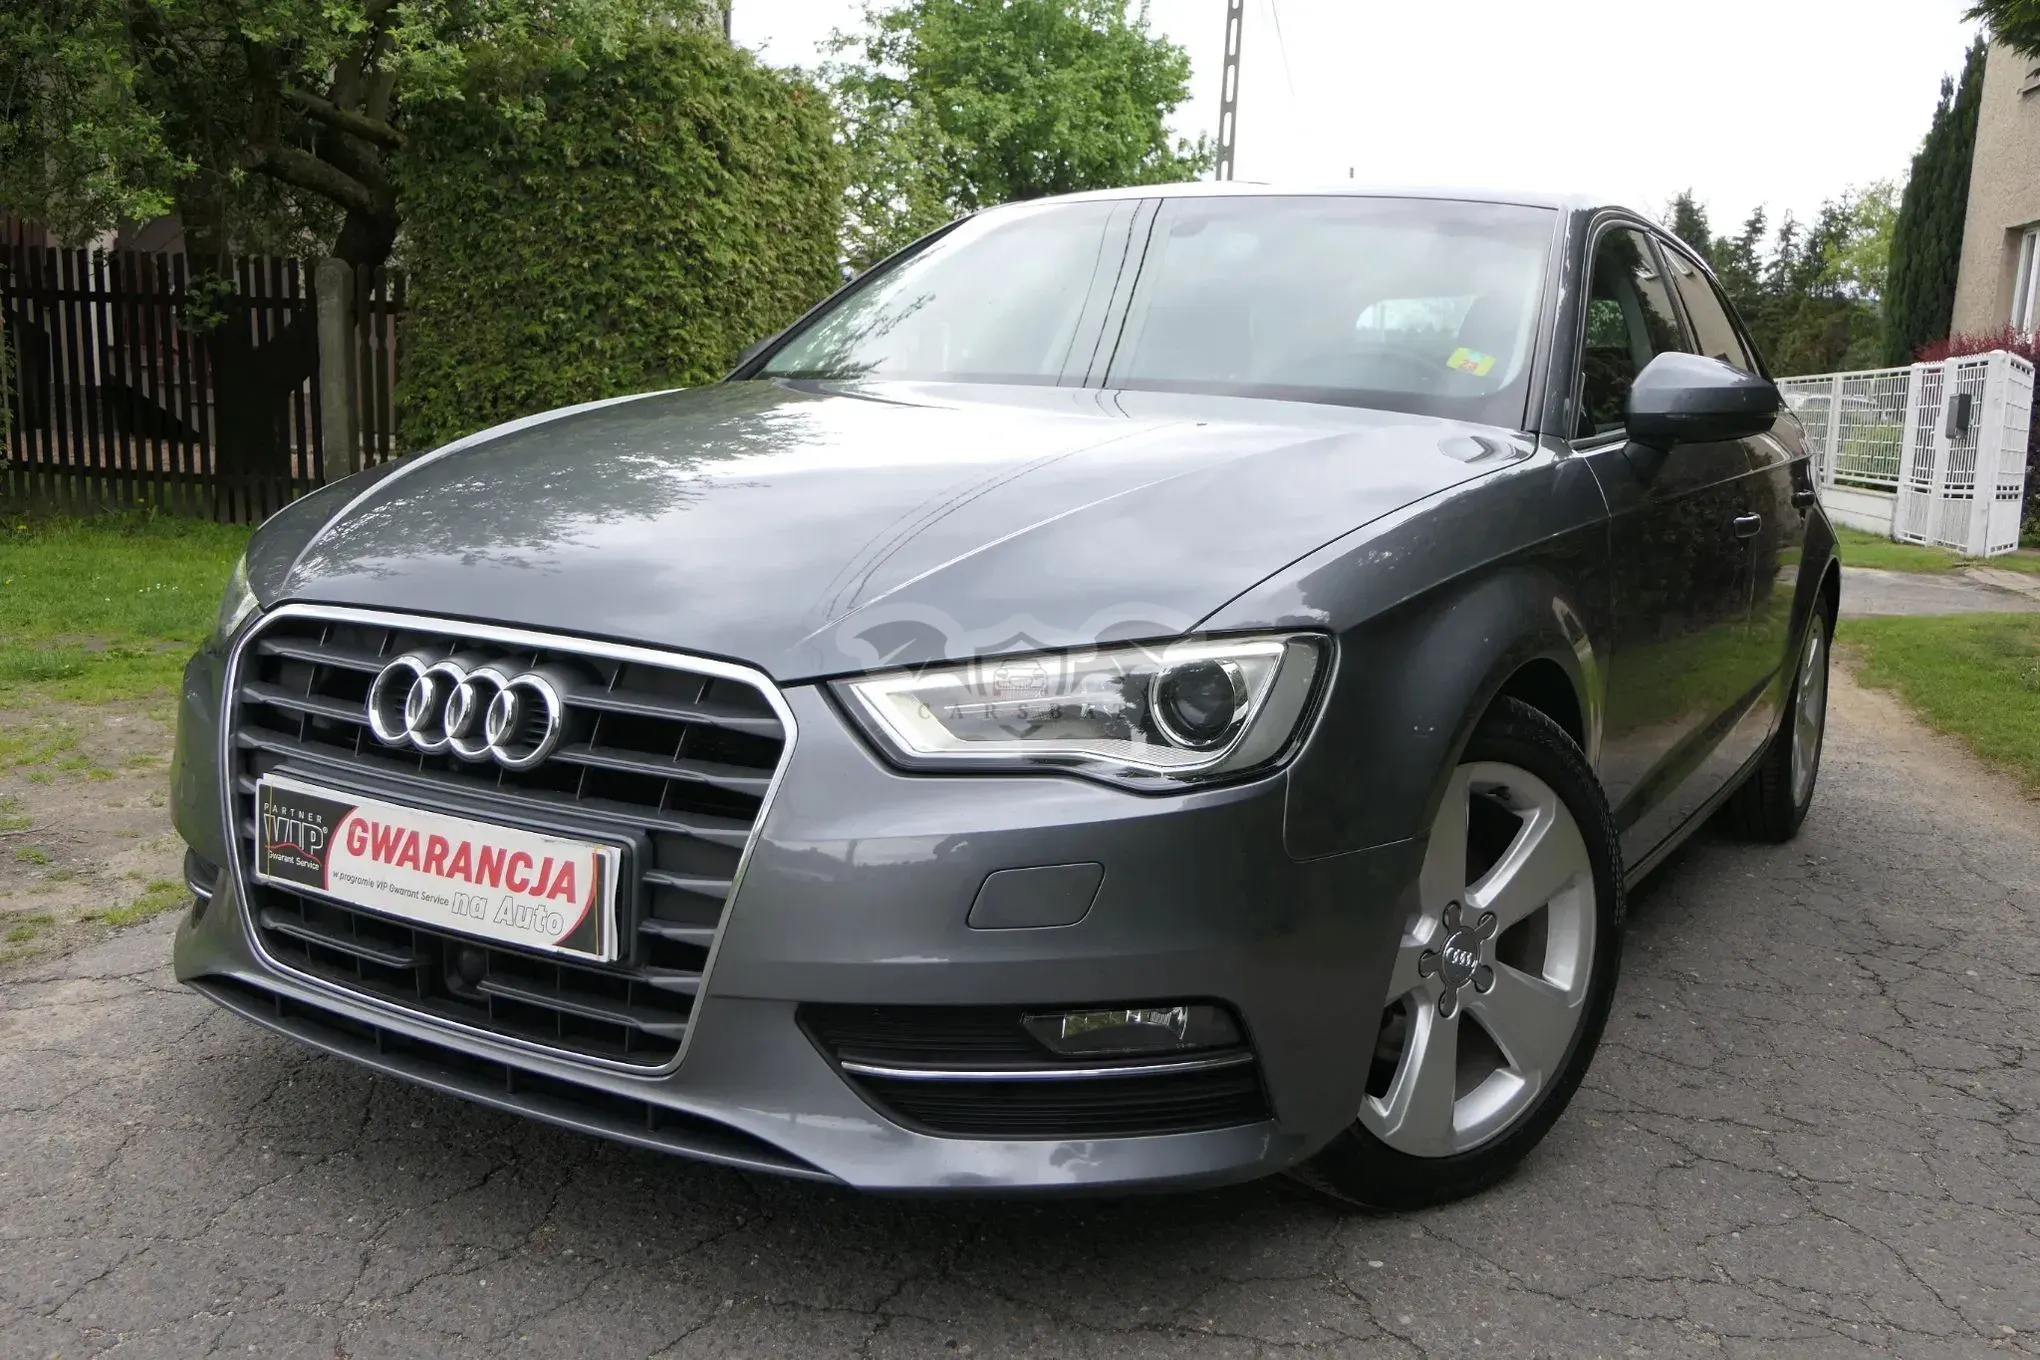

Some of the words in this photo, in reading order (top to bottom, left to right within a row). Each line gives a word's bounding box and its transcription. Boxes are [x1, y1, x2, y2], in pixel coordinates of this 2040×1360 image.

[263, 802, 322, 824] PARTNER
[268, 850, 295, 864] Gwarant
[295, 856, 320, 871] Service
[347, 817, 577, 904] GWARANCJA
[339, 872, 375, 888] programie
[376, 879, 389, 891] VIP
[388, 883, 420, 900] Gwarant
[420, 890, 450, 906] Service
[451, 891, 489, 921] na
[492, 895, 565, 936] Auto
